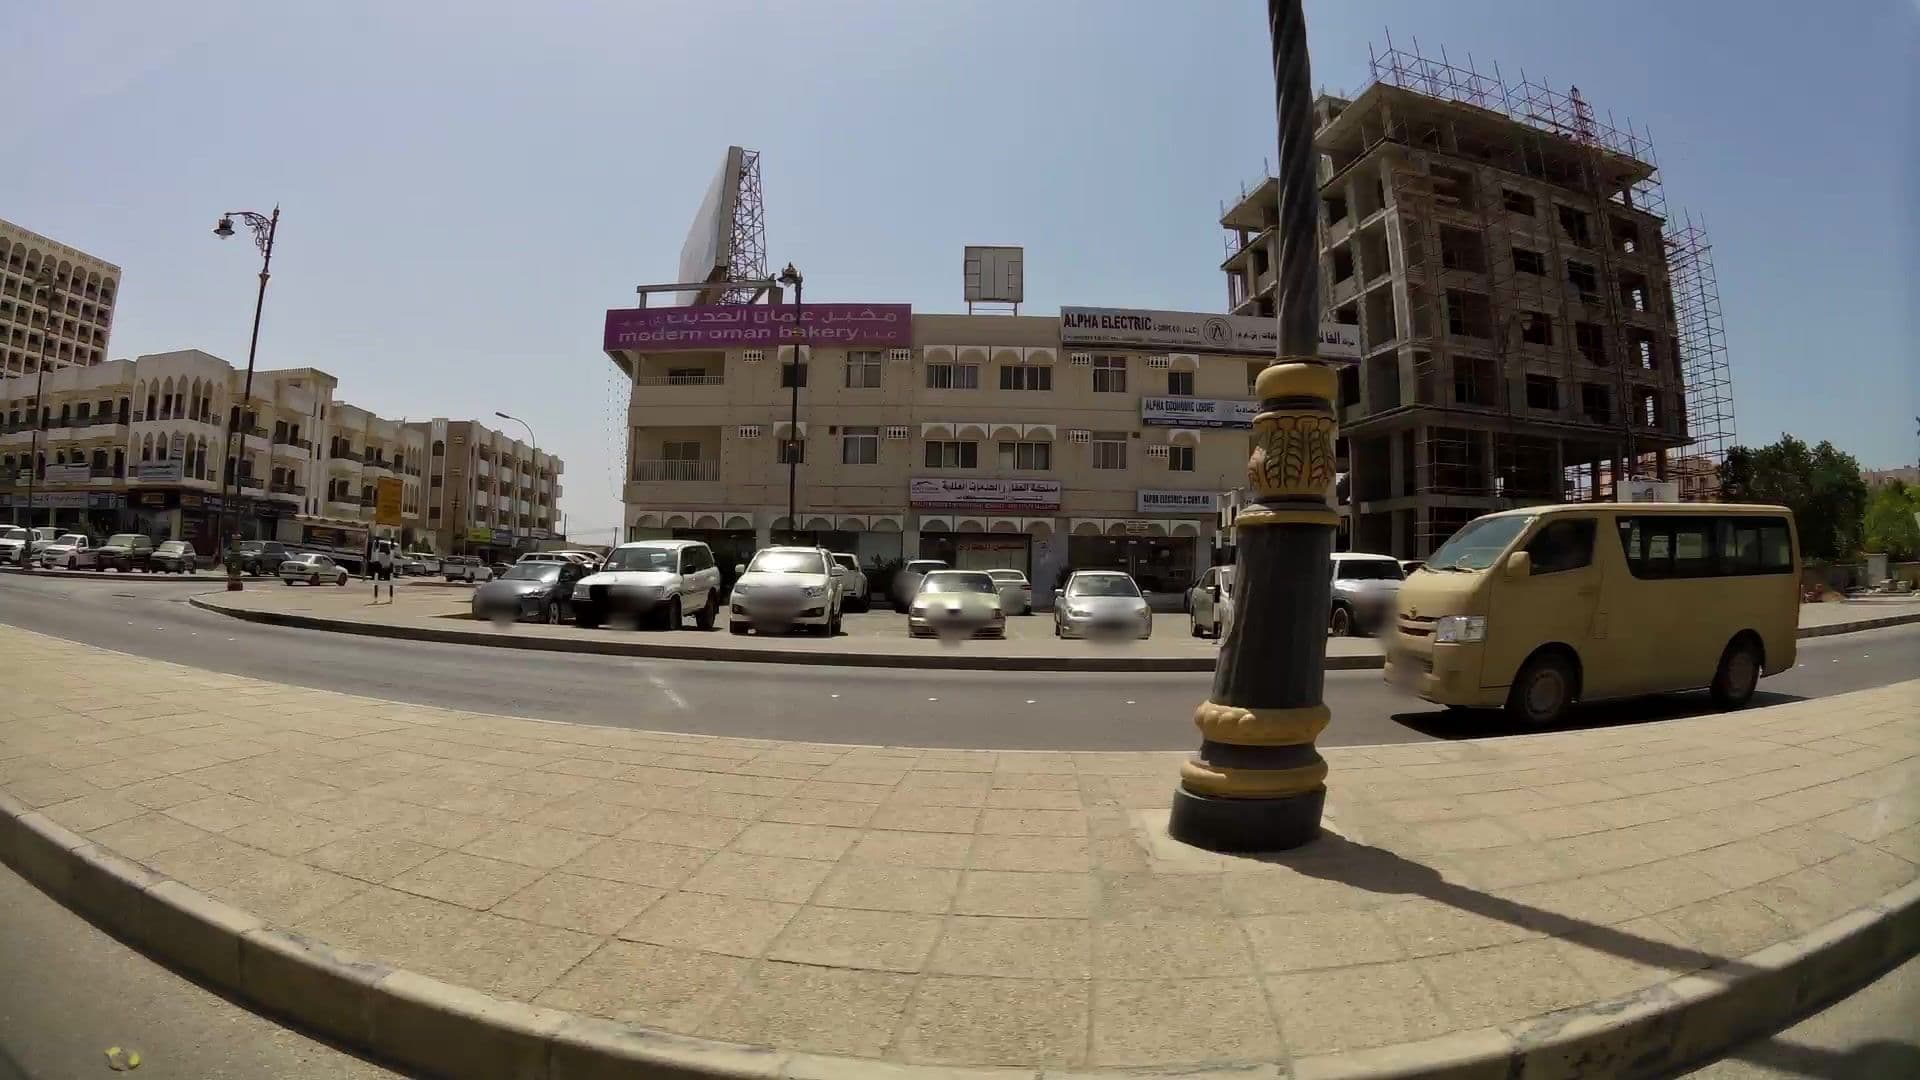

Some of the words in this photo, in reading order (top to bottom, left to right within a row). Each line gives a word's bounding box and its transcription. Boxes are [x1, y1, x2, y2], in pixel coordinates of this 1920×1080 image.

[1063, 313, 1099, 329] ALPHA
[1101, 315, 1152, 331] ELECTRIC
[618, 326, 701, 343] modern
[709, 328, 771, 340] oman
[779, 325, 860, 341] bakery
[1144, 399, 1164, 412] ALPHA
